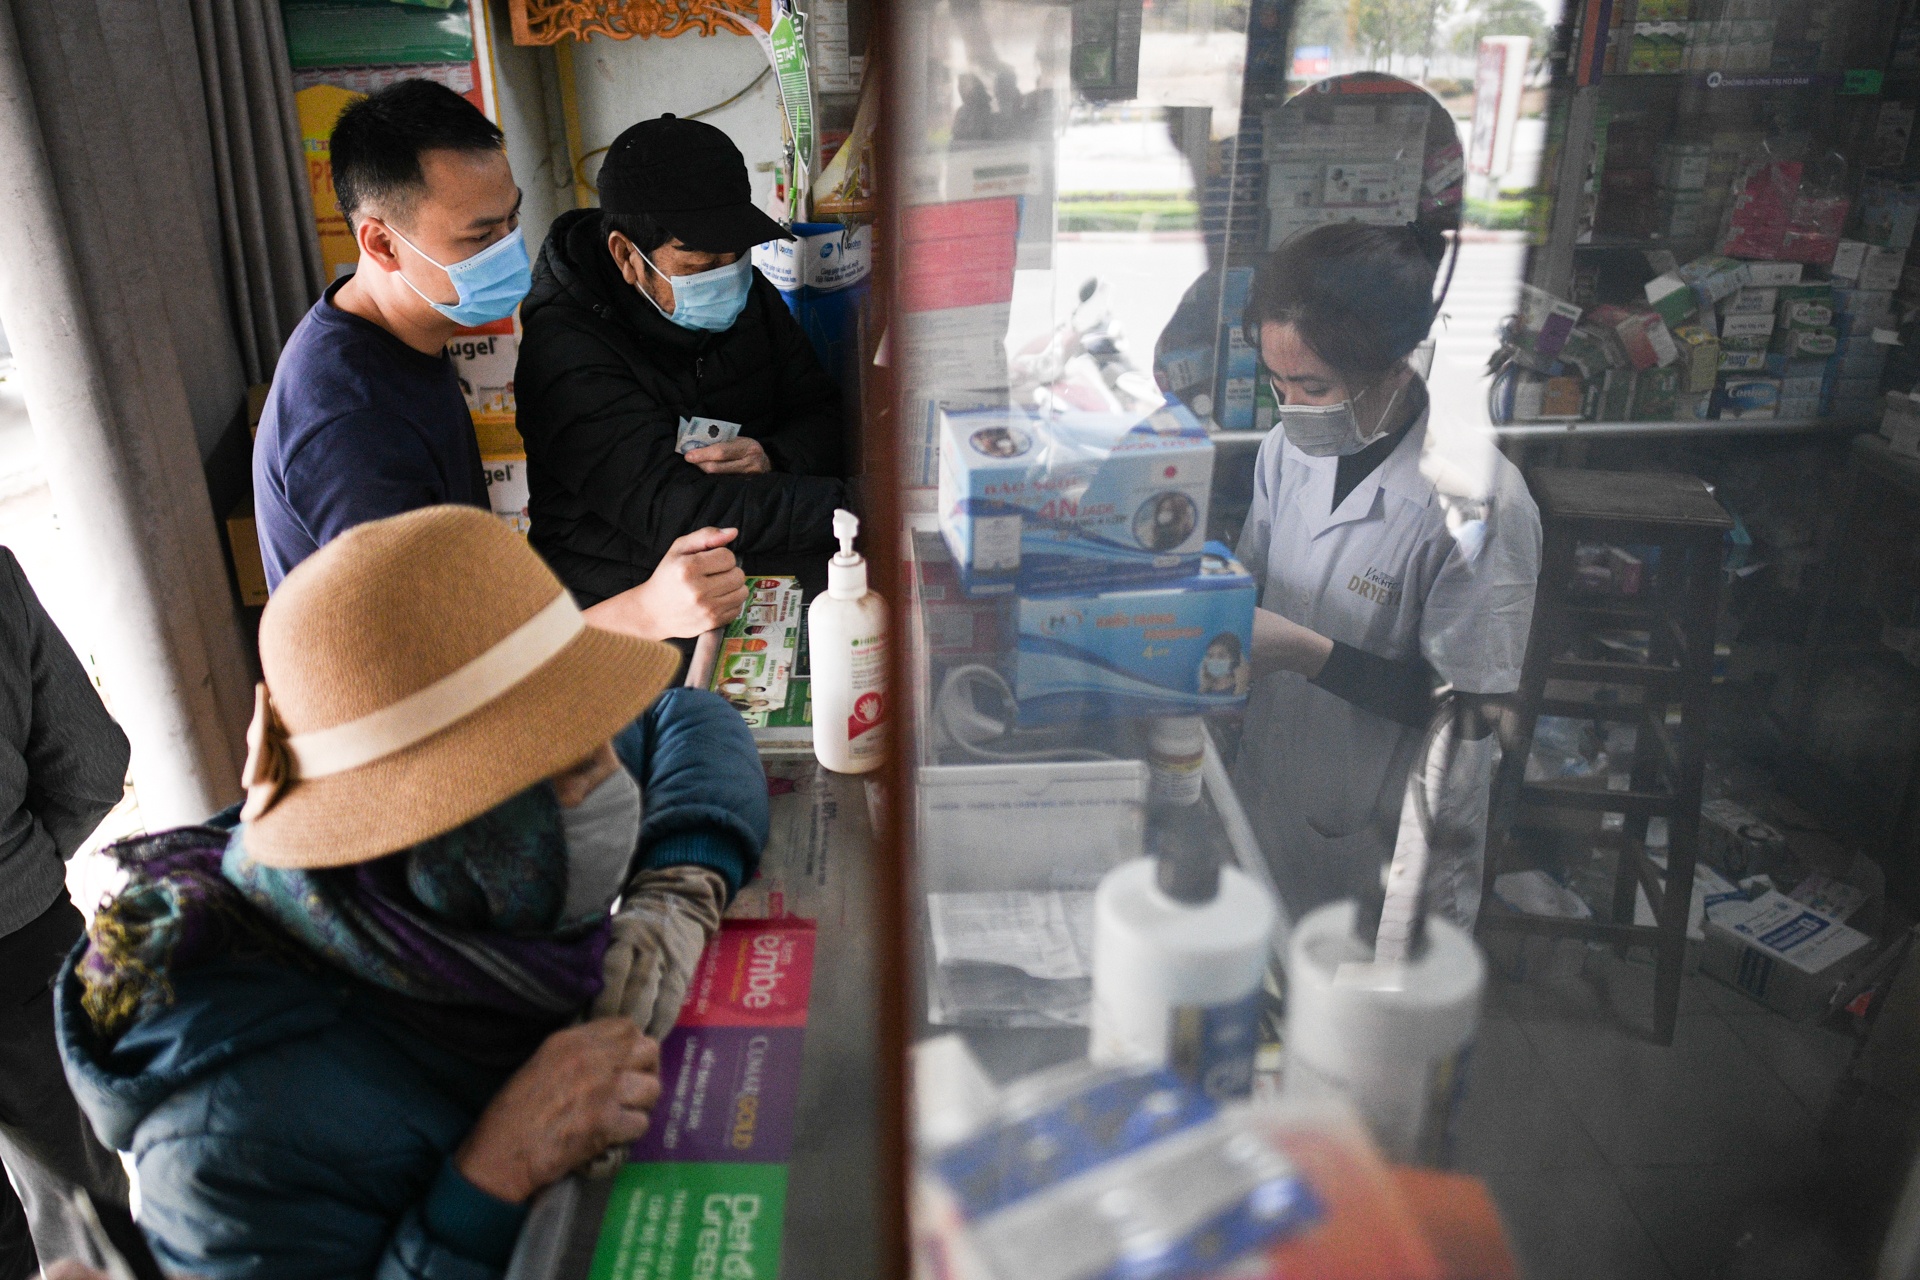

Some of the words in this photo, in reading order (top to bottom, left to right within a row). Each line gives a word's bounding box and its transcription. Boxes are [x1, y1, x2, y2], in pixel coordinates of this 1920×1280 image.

[776, 44, 797, 63] STAR
[449, 336, 494, 360] ugel
[484, 465, 511, 486] gel
